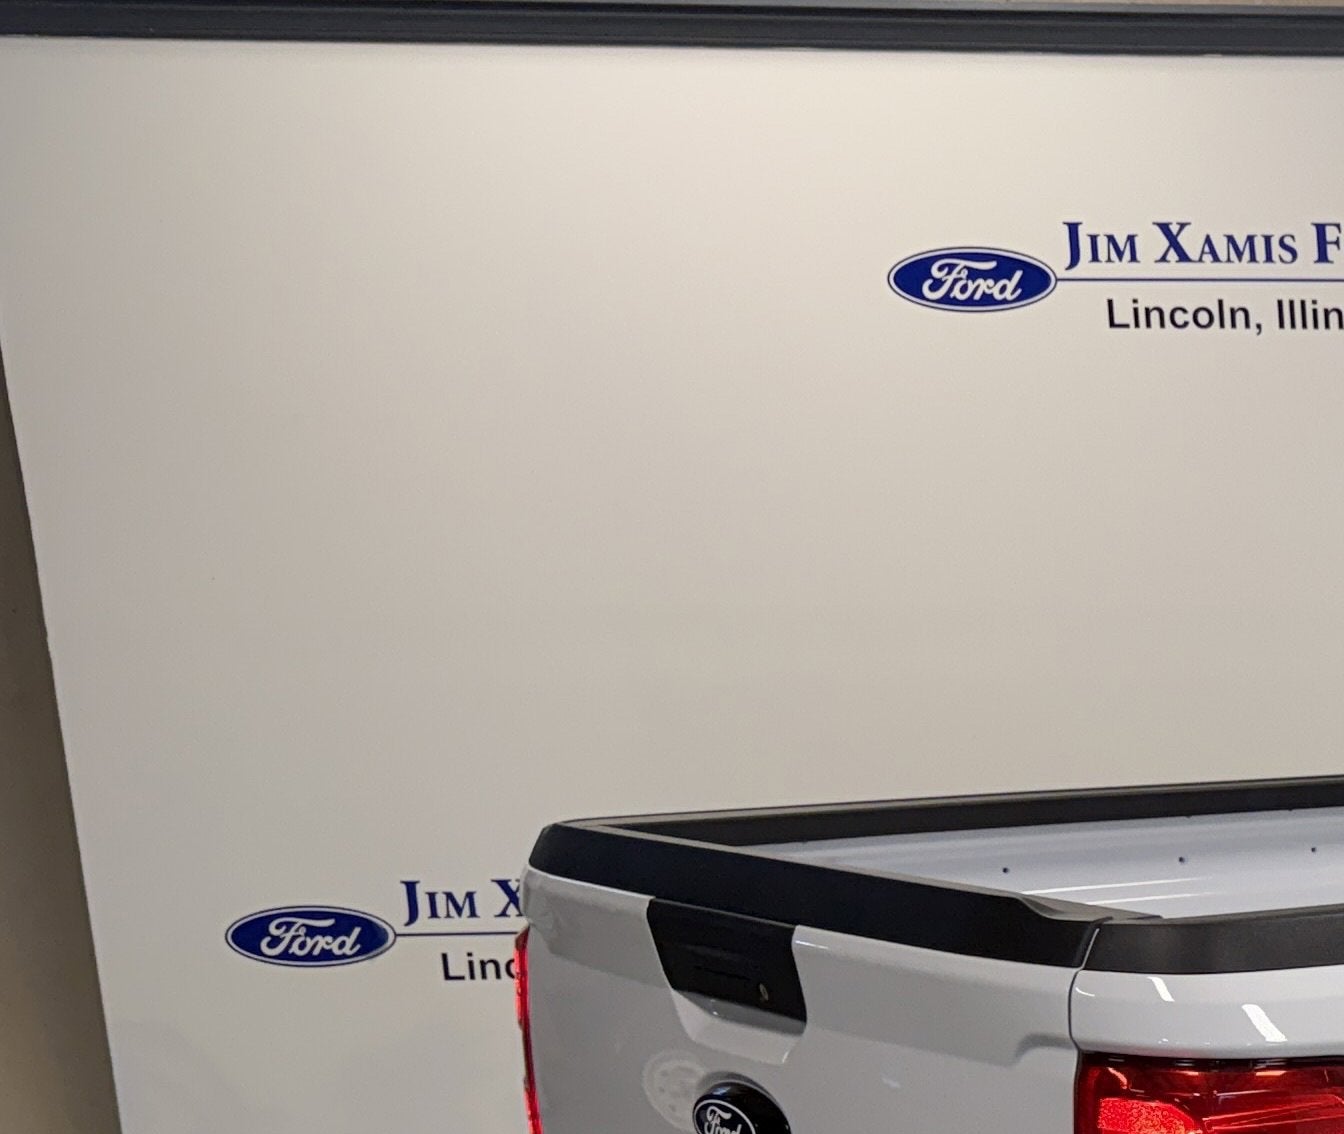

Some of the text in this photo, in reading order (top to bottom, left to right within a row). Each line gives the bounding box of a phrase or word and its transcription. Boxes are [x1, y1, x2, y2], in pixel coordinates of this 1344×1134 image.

[921, 259, 1023, 301] Ford
[1106, 298, 1263, 336] Lincoln,
[259, 916, 361, 957] Ford
